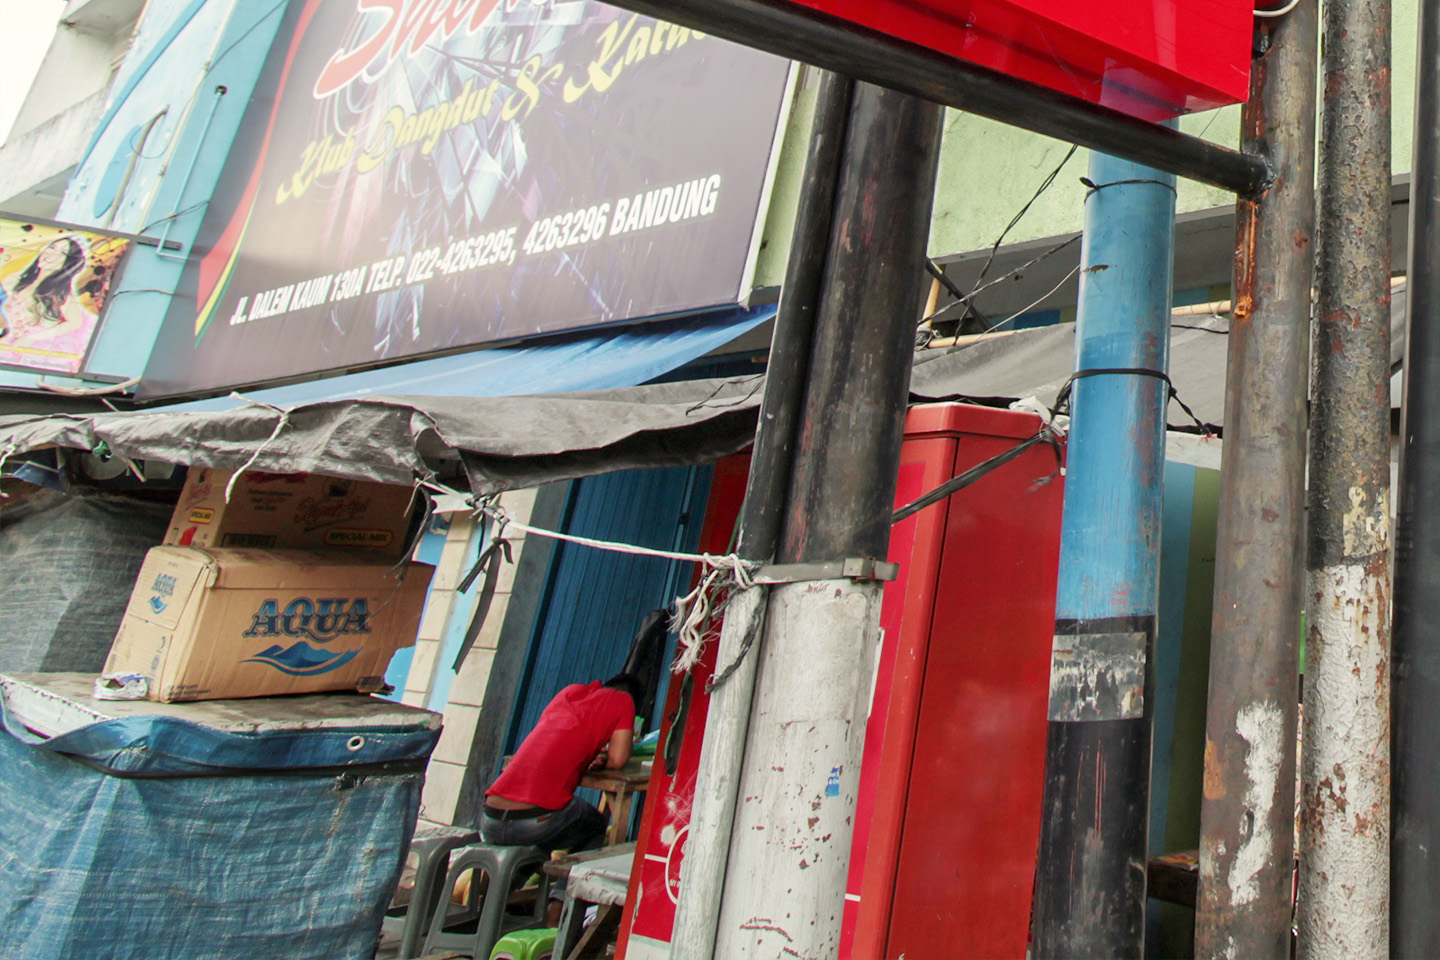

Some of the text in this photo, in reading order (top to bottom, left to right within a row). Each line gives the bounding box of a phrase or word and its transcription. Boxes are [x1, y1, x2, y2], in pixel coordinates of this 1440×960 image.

[275, 126, 356, 205] Klub
[356, 75, 501, 174] Dangdut
[562, 12, 707, 104] Kara
[247, 284, 296, 321] DALEM
[288, 274, 334, 312] KAUM
[329, 266, 368, 302] 130A
[364, 255, 406, 294] TELP.
[521, 202, 611, 256] 4263296
[608, 173, 722, 236] BANDUNG
[242, 597, 373, 644] AQUA
